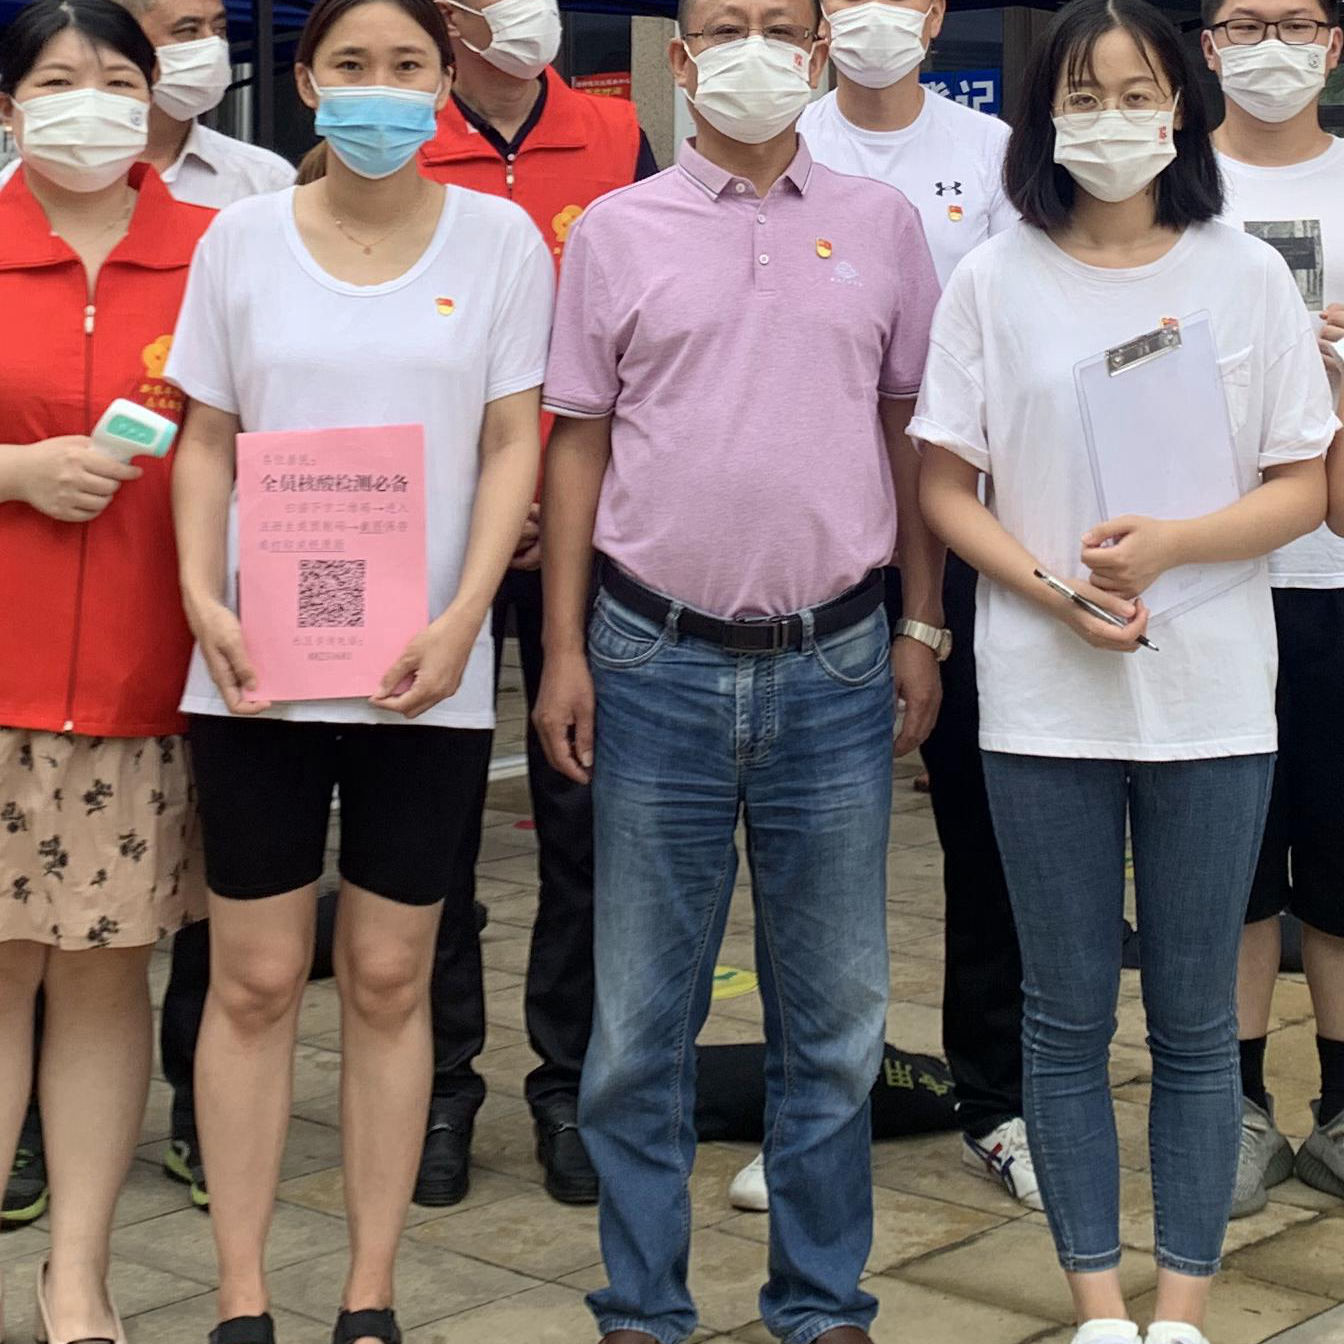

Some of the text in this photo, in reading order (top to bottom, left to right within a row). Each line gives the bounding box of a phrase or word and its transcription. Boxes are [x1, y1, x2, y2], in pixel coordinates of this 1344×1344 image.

[260, 474, 408, 493] 全员核酸检测必备
